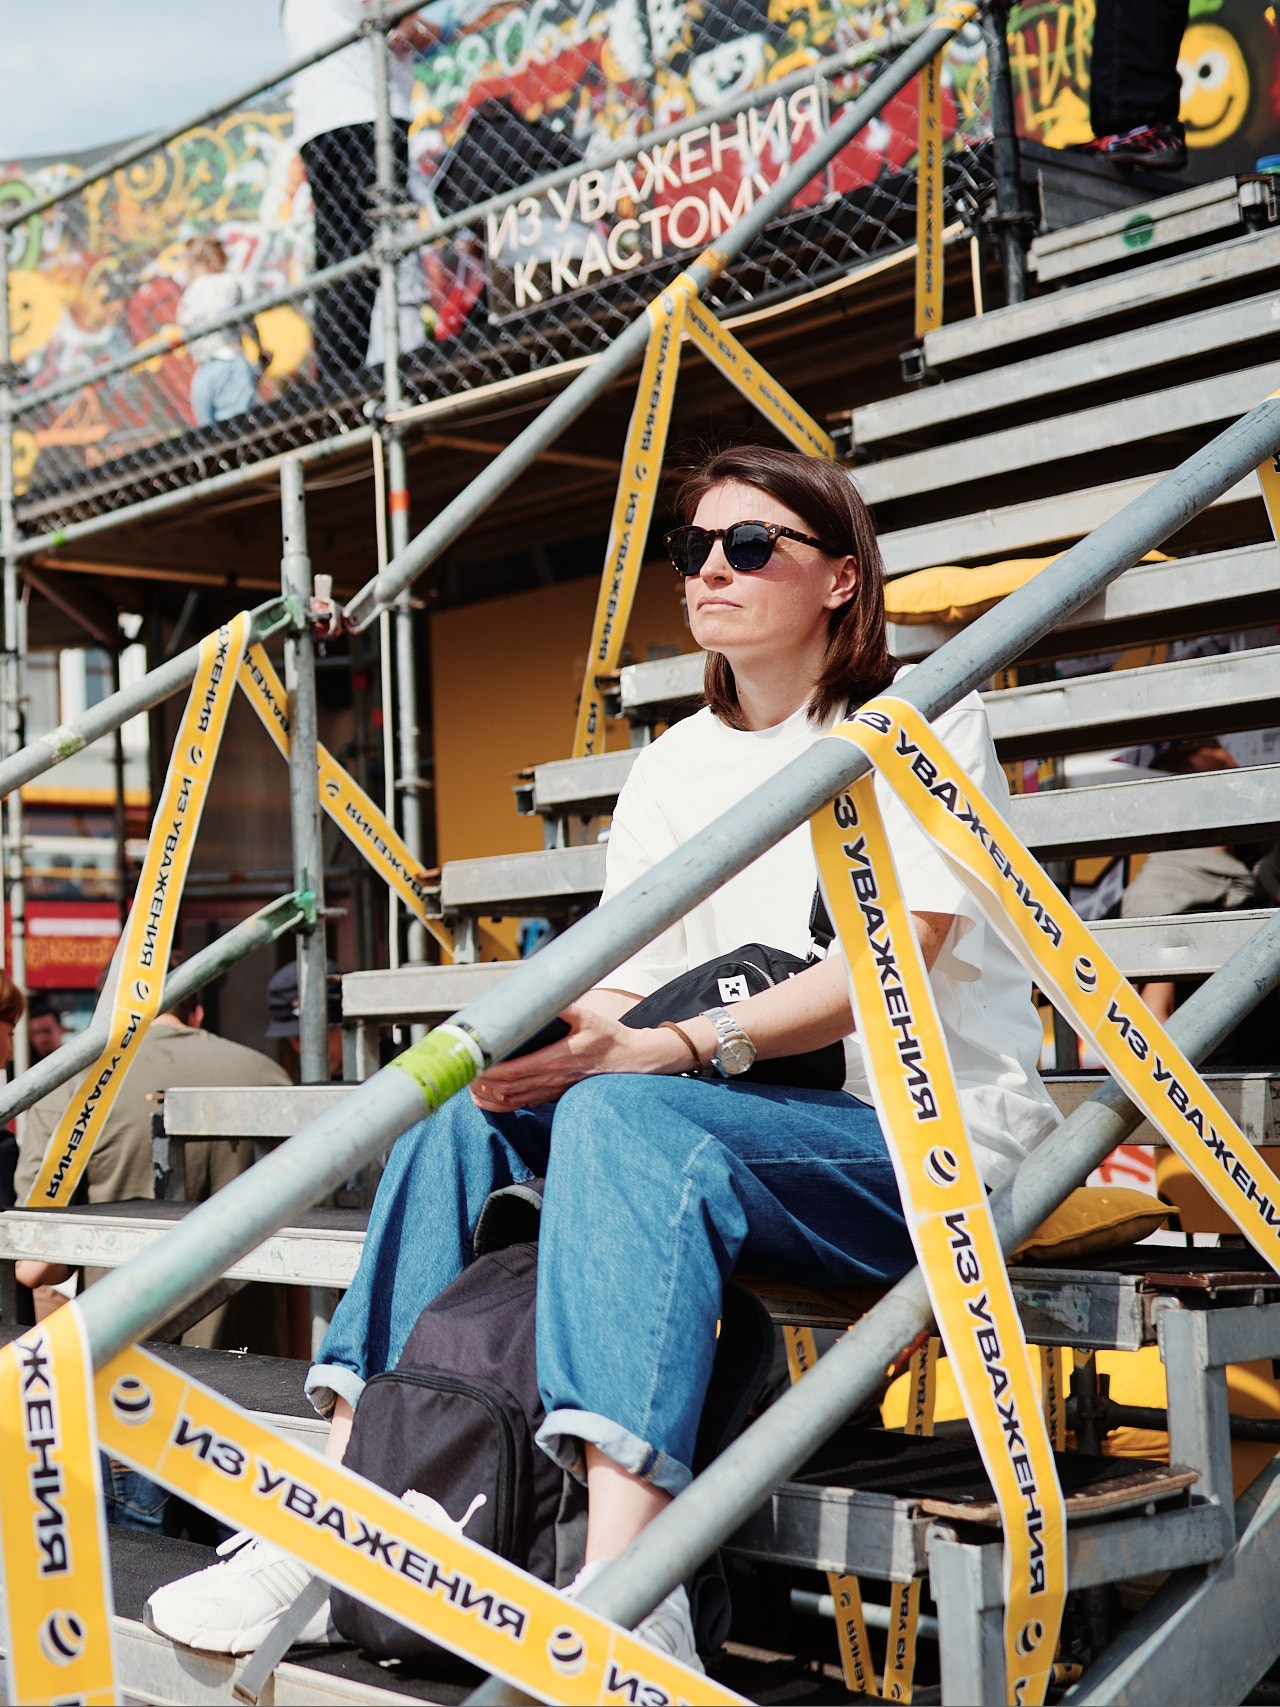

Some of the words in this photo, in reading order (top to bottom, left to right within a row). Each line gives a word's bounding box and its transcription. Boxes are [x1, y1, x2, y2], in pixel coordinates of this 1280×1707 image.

[487, 198, 543, 261] ИЗ
[549, 84, 822, 233] УВАЖЕНИЯ
[514, 256, 543, 307] К
[638, 314, 673, 453] УВАЖЕНИЯ
[624, 491, 640, 525] ИЗ
[598, 529, 633, 660] УВАЖЕНИЯ
[199, 630, 230, 732] ЖЕНИЯ
[174, 776, 192, 813] ИЗ
[833, 789, 859, 830] З
[139, 816, 186, 968] УВАЖЕНИЯ
[119, 1013, 142, 1049] ИЗ
[843, 837, 939, 1120] УВАЖЕНИЯ
[893, 729, 1063, 948] УВАЖЕНИЯ
[1106, 1000, 1150, 1061] ИЗ
[1152, 1056, 1280, 1238] УВАЖЕНИ
[46, 1054, 122, 1199] УВАЖЕНИЯ
[944, 1212, 981, 1286] ИЗ
[18, 1336, 69, 1574] ЖЕНИЯ
[968, 1293, 1045, 1597] УВАЖЕНИЯ
[174, 1417, 246, 1477] ИЗ
[255, 1464, 527, 1640] УВАЖЕНИЯ
